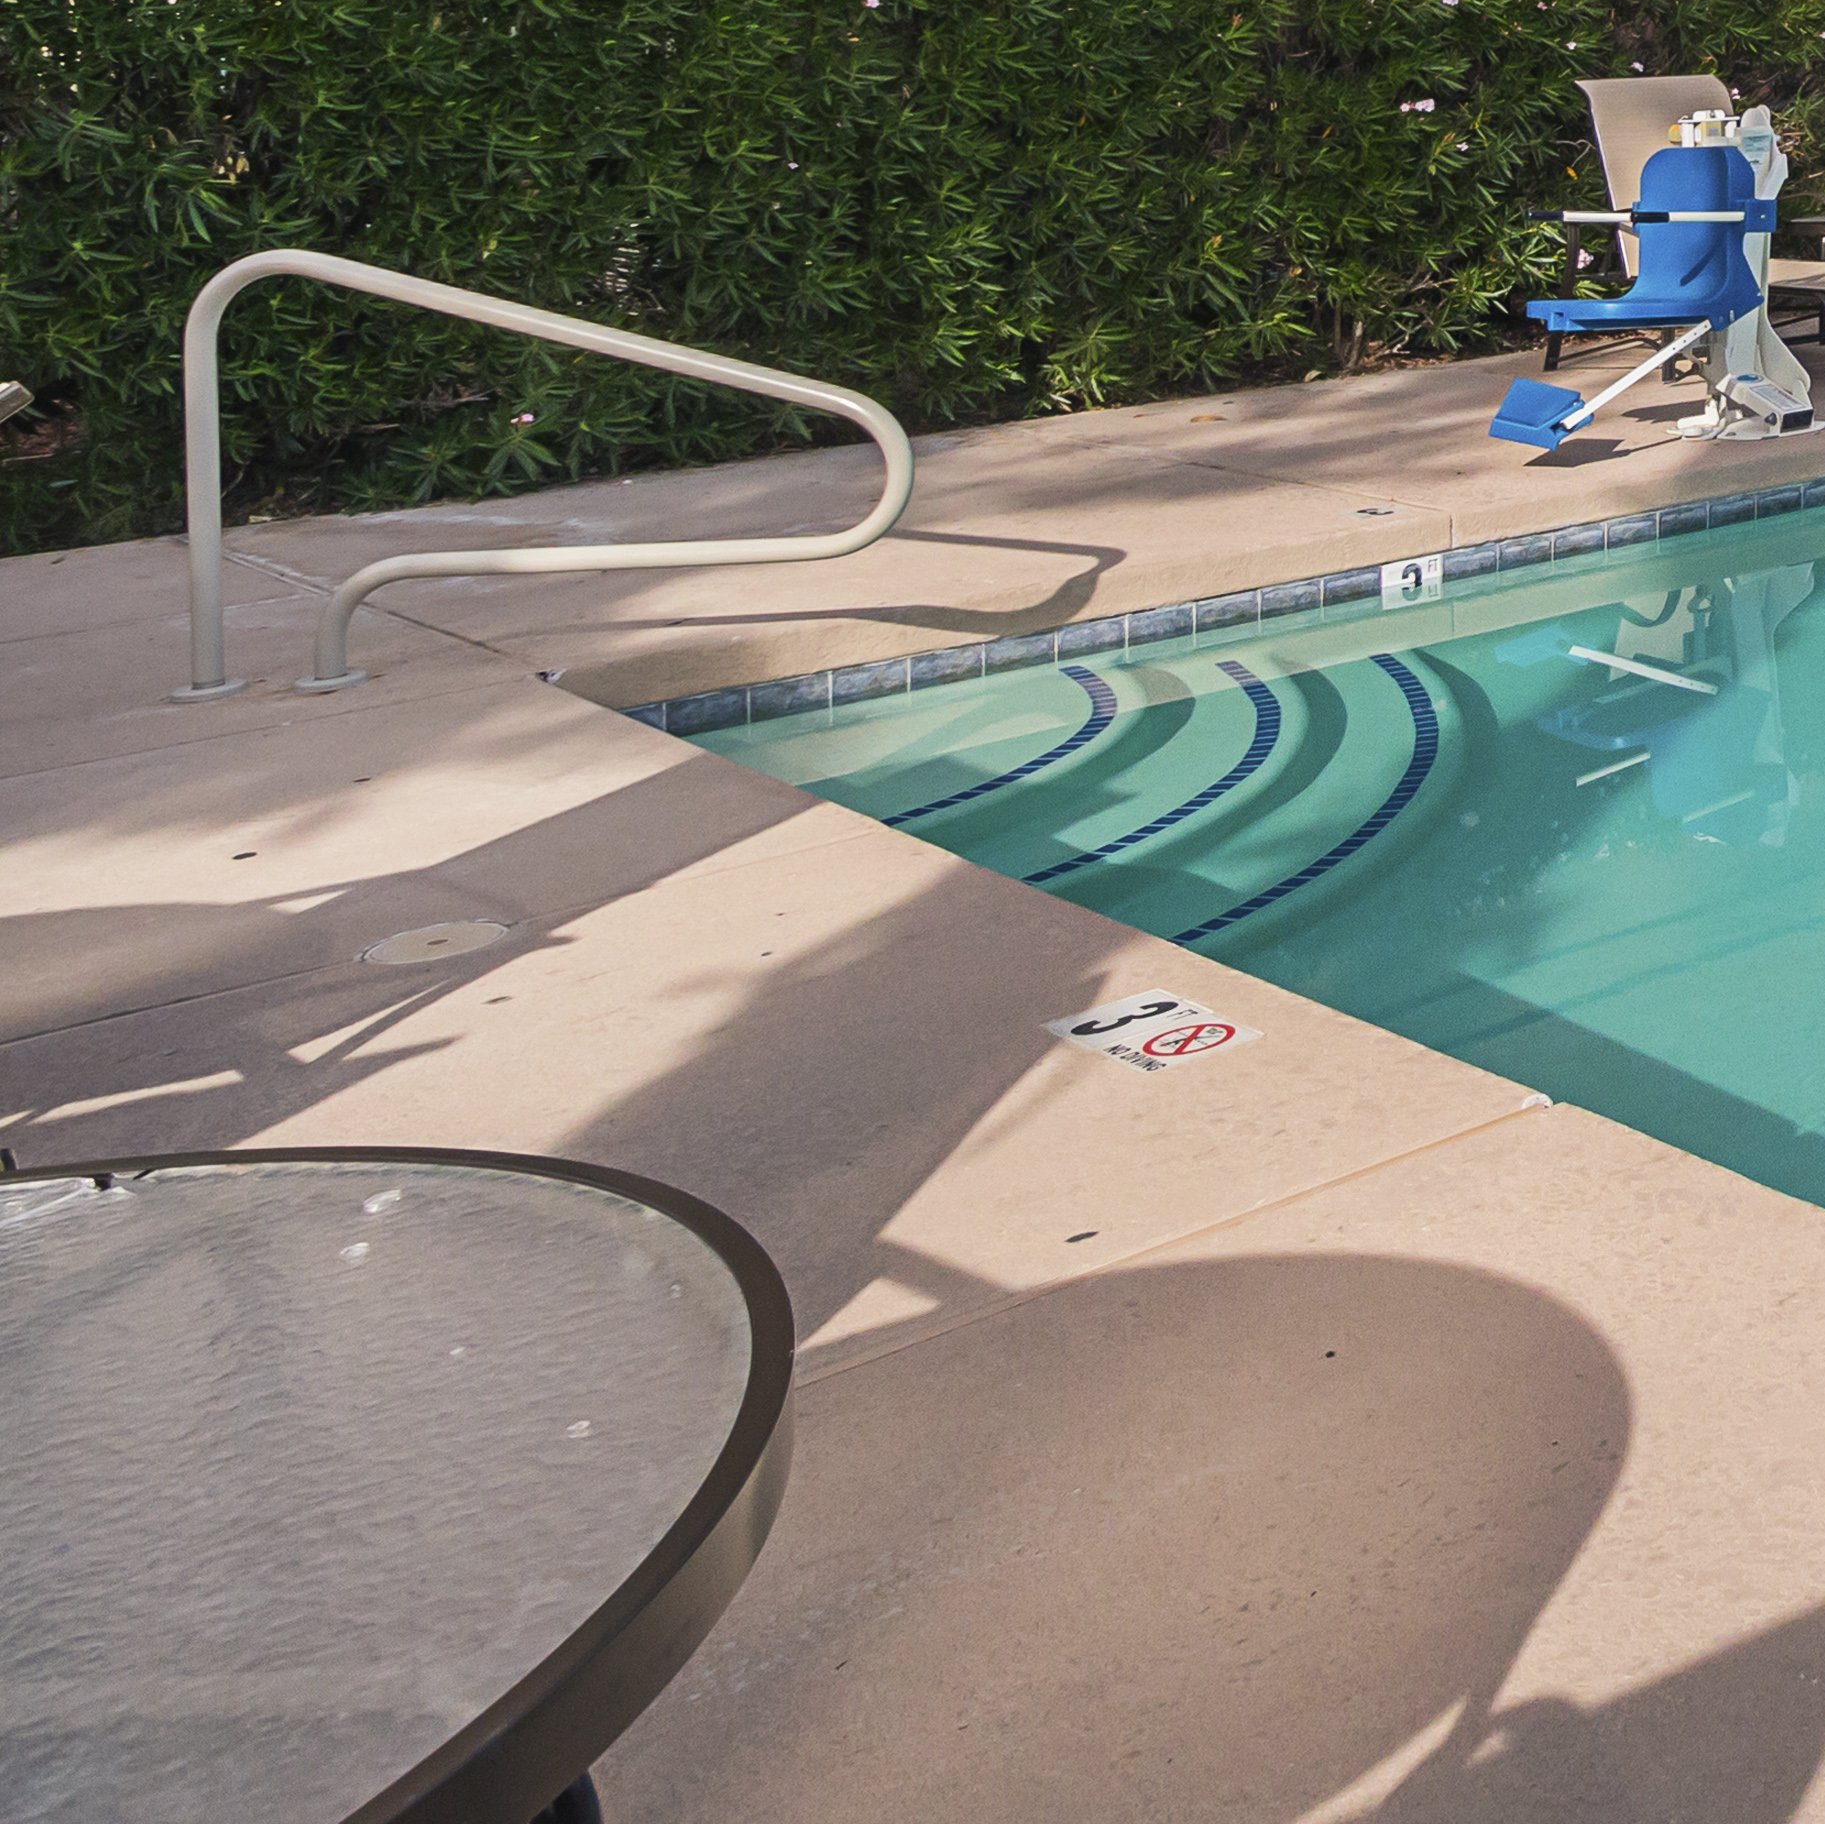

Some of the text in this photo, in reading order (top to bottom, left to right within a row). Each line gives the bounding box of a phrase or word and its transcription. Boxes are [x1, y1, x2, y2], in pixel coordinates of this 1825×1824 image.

[1428, 558, 1438, 572] FT
[1070, 1001, 1179, 1036] 3
[1104, 1043, 1167, 1072] NO DIVING
